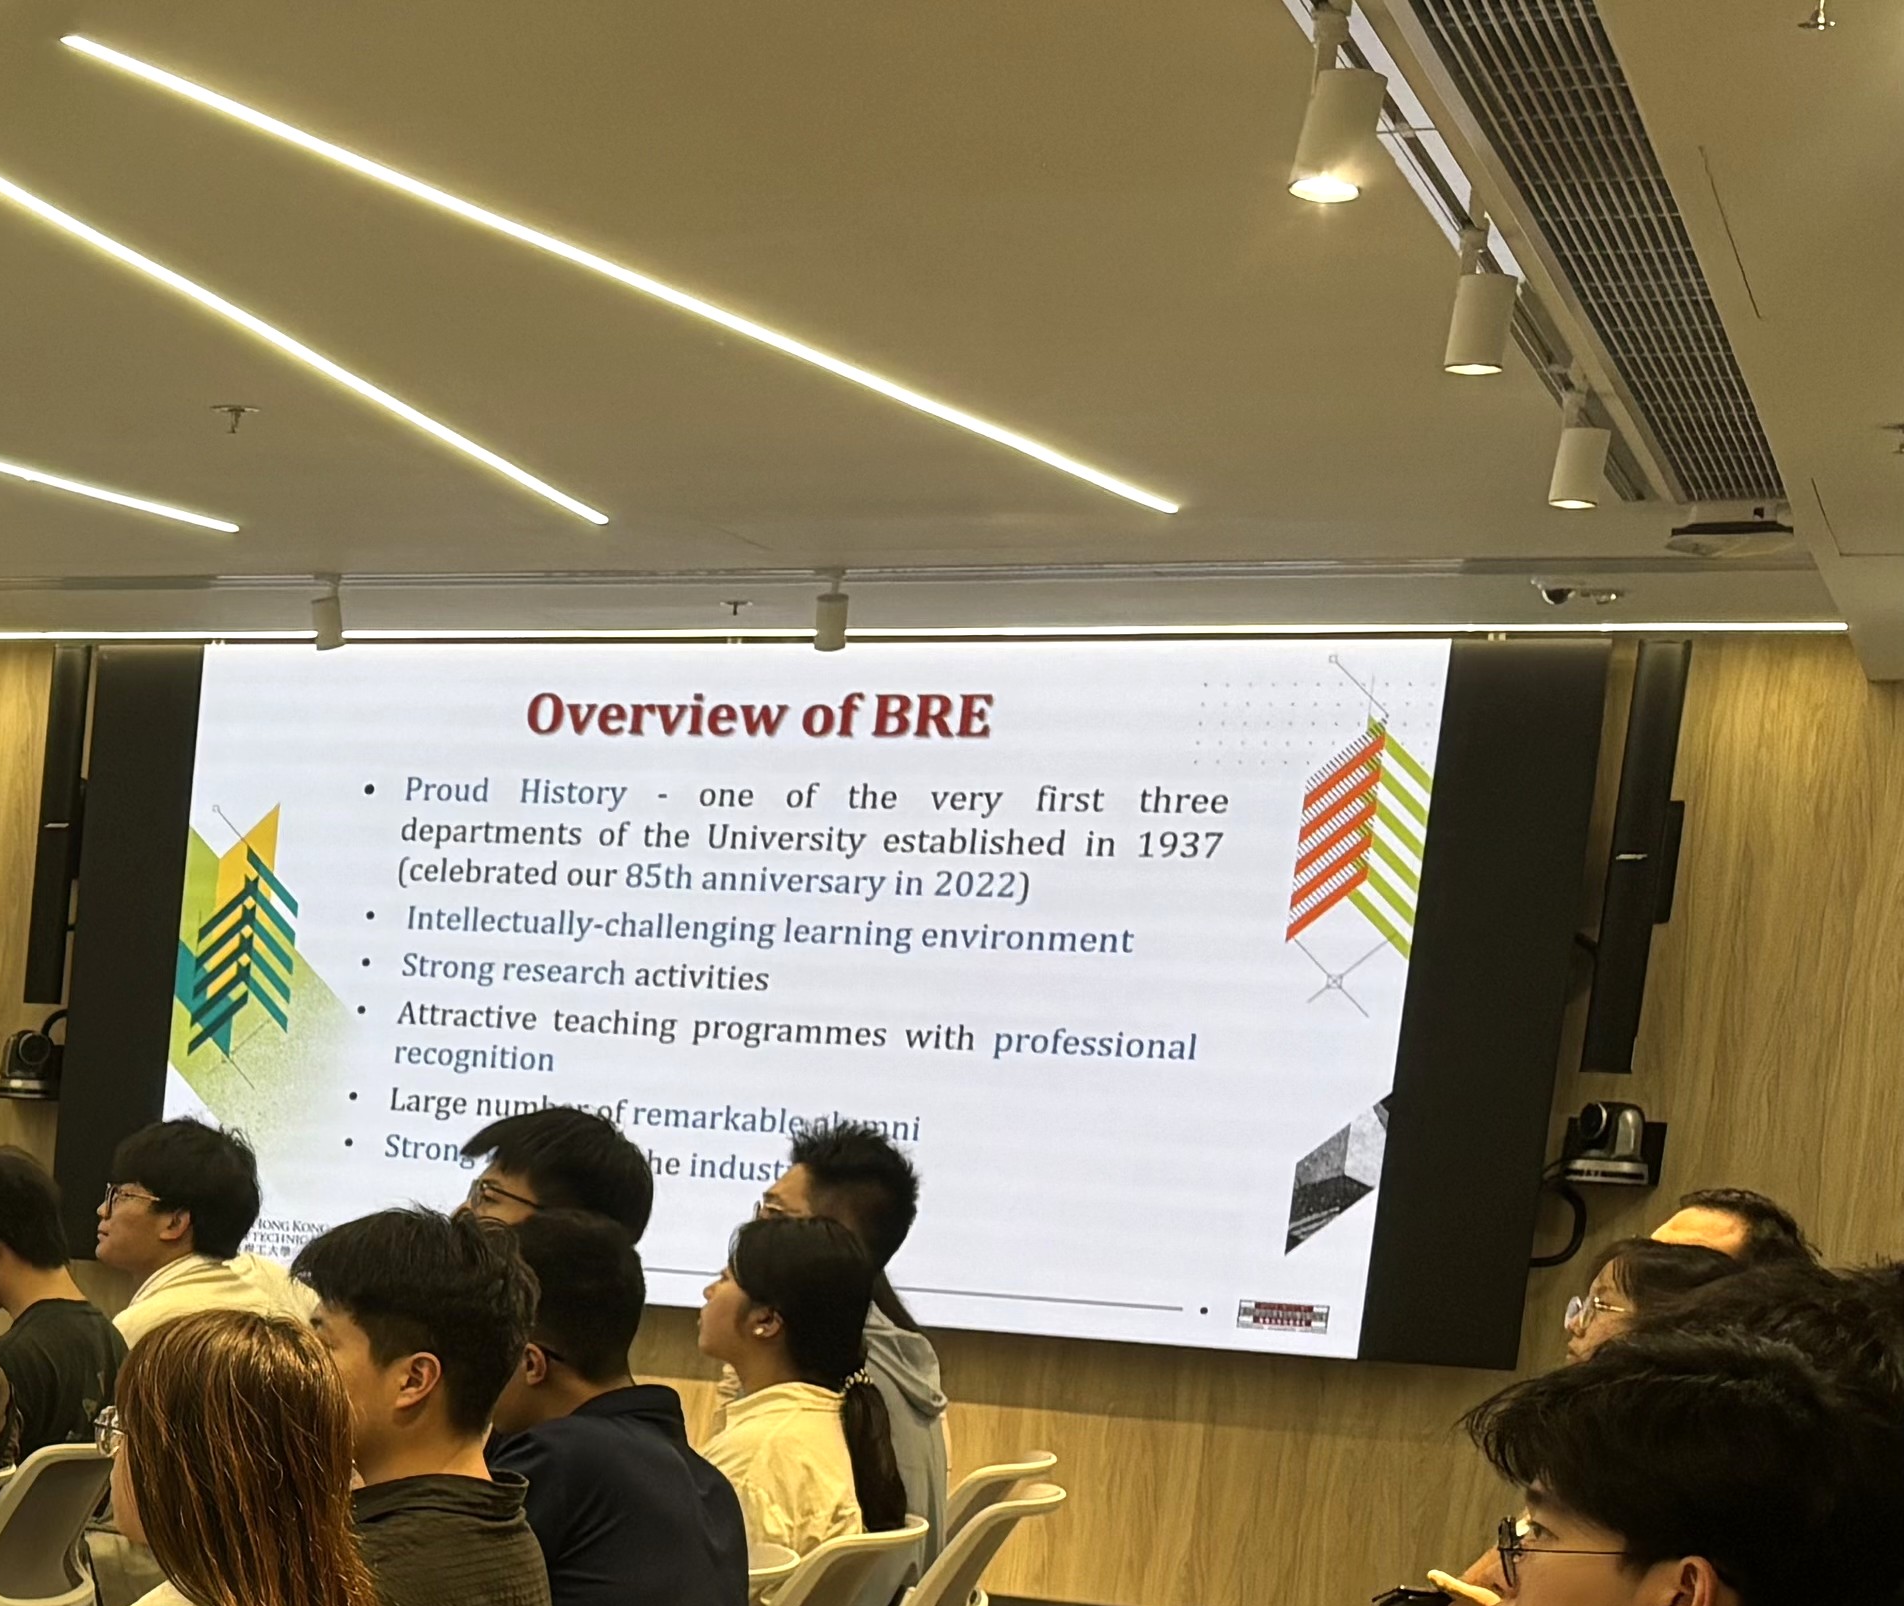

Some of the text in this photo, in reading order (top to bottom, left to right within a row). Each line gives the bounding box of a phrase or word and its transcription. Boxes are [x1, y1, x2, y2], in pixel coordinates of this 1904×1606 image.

[527, 692, 994, 739] Overview of BRE
[405, 776, 489, 803] Proud
[520, 778, 628, 813] History
[699, 788, 754, 808] one
[786, 782, 821, 809] of
[849, 782, 898, 810] the
[931, 791, 1004, 819] very
[1036, 784, 1105, 813] first
[1140, 785, 1229, 814] three
[401, 816, 1224, 860] departments of the University established in 1937
[398, 856, 1030, 906] (celebrated our 85th anniversary in 2022)
[407, 905, 1135, 954] Intellectually-challenging learning environment
[401, 952, 770, 991] Strong research activities
[396, 1000, 1197, 1061] Attractive teaching programmes with professional
[394, 1044, 554, 1074] recognition
[390, 1087, 467, 1120] Large
[633, 1104, 804, 1133] remarkable
[648, 1149, 786, 1182] he indust
